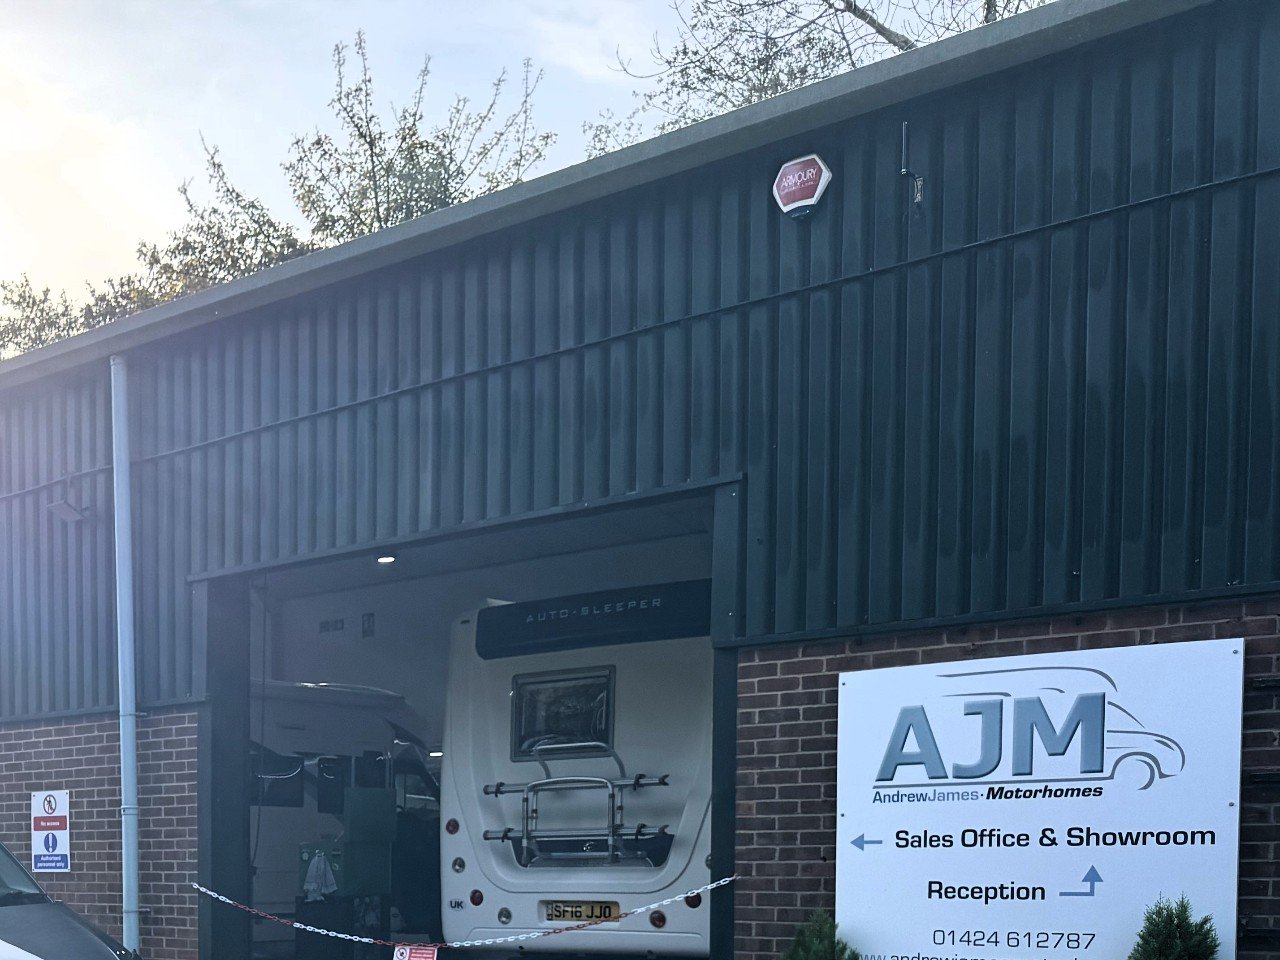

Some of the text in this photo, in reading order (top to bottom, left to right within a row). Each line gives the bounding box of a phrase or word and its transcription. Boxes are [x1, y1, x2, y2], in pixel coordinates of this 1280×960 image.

[781, 168, 817, 188] ARMOURY
[875, 692, 1106, 782] AJM
[895, 826, 1216, 848] Sales Office & Showroom
[927, 880, 1046, 905] Reception
[450, 900, 464, 909] UK
[554, 904, 583, 918] SF16
[933, 929, 1096, 950] 01424 612787
